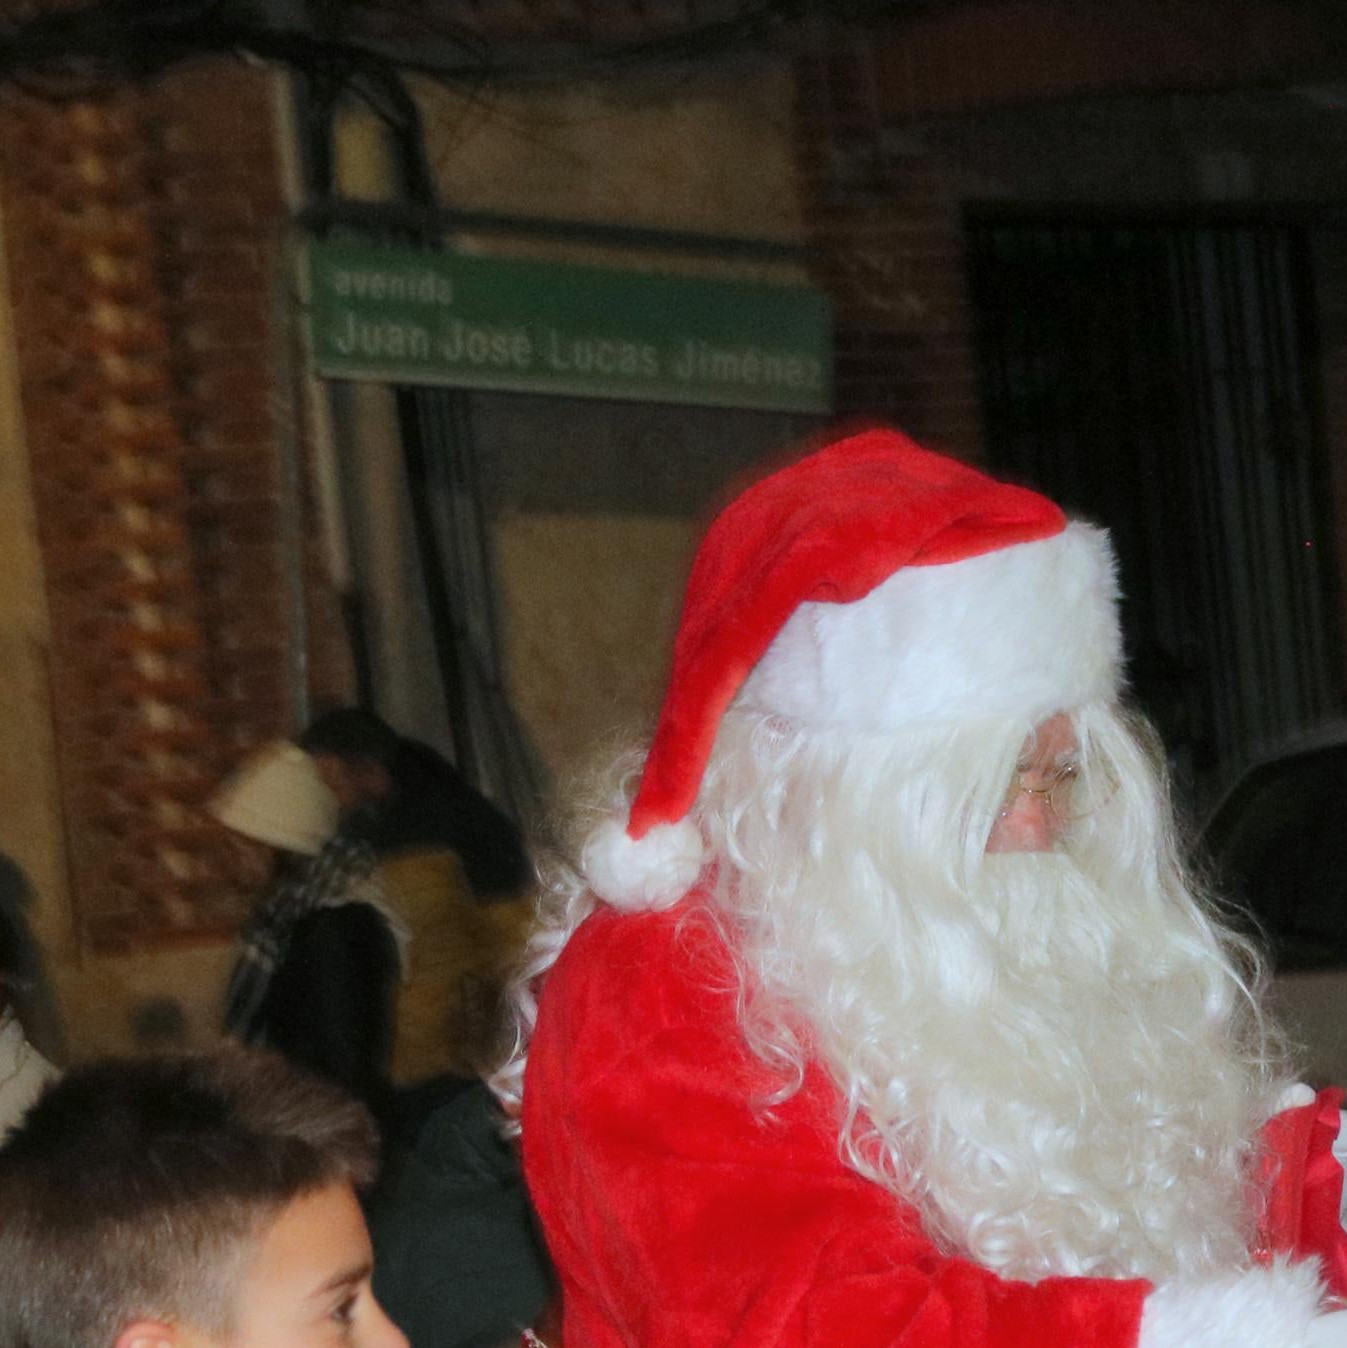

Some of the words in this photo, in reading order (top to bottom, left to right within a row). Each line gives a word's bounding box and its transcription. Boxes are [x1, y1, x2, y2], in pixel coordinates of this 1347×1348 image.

[333, 271, 451, 305] avenida
[333, 312, 430, 359] Juan
[441, 320, 532, 367] José
[549, 328, 660, 377] Lucas
[675, 339, 822, 388] Jiménez
